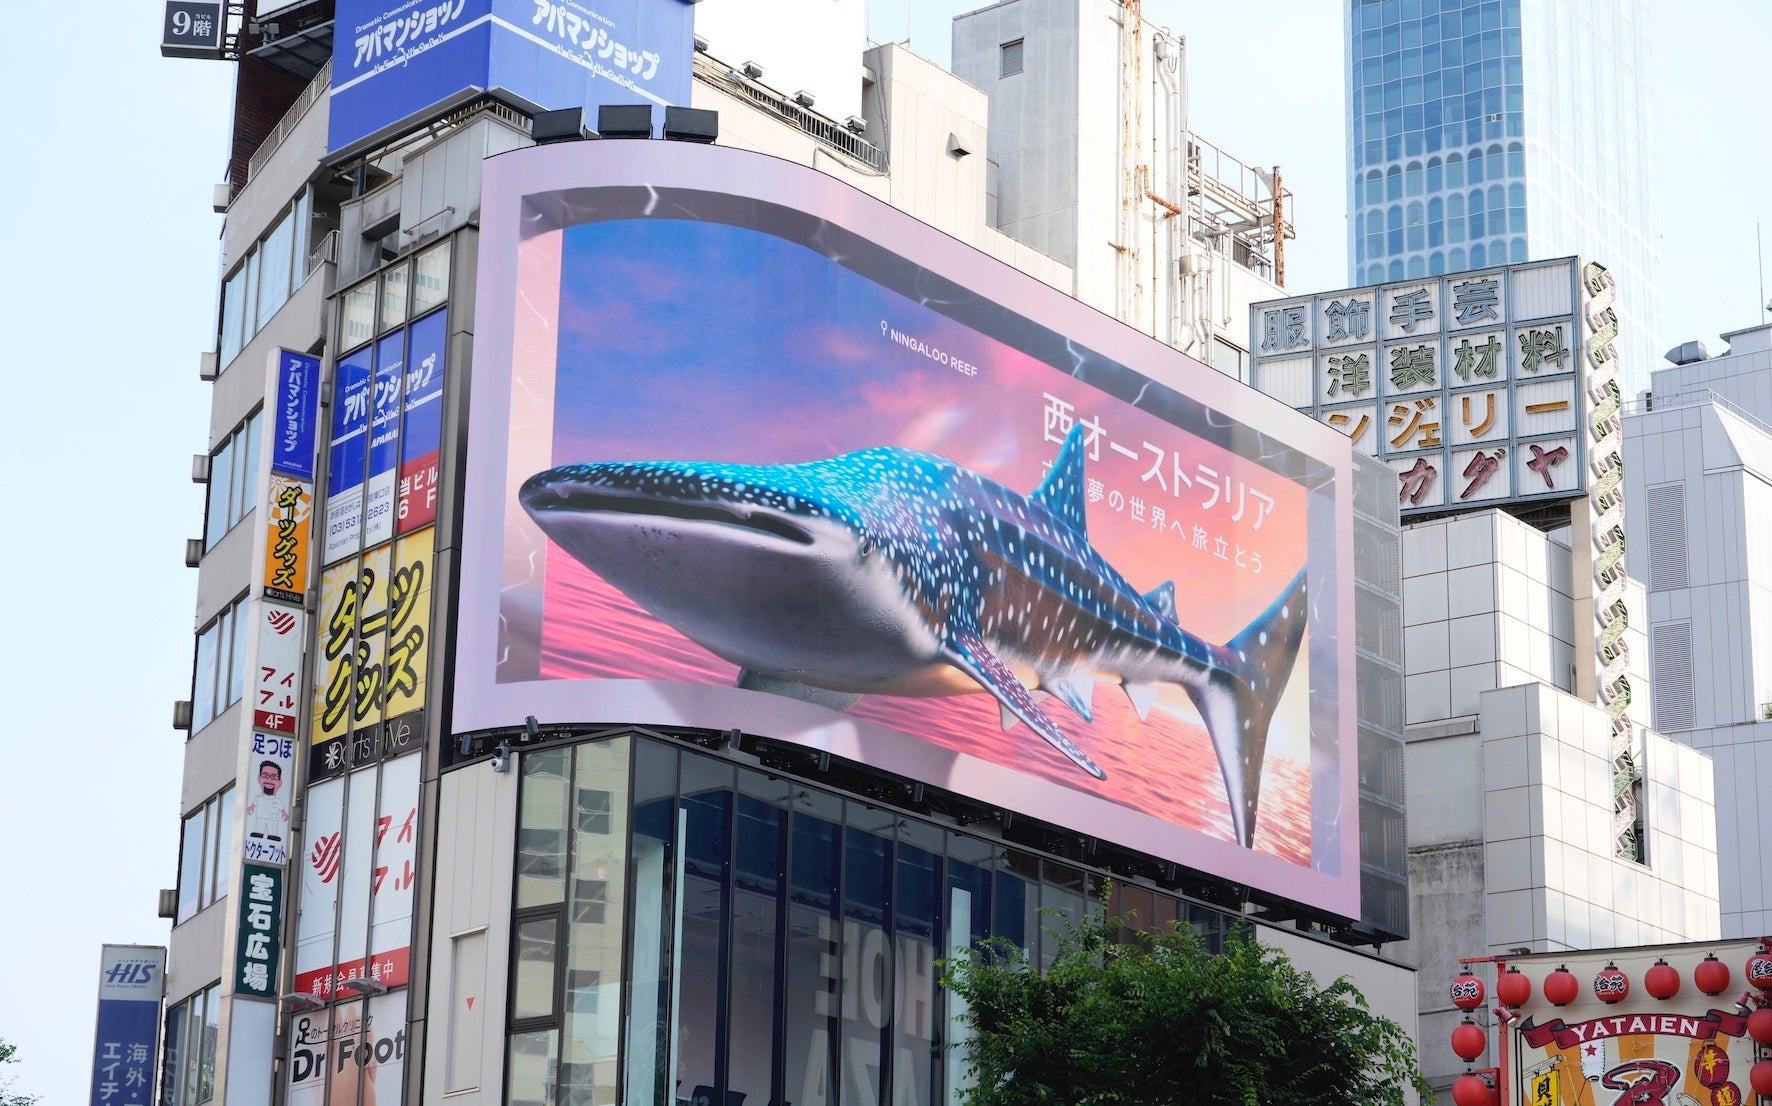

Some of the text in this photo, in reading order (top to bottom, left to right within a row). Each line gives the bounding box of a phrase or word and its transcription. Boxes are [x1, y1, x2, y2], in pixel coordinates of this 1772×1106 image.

[1261, 279, 1498, 351] 服飾手芸
[890, 328, 978, 377] NINGALOO REEF
[1326, 326, 1570, 397] 洋装材料
[284, 358, 303, 453] アパマンショップ
[399, 466, 438, 499] 当ビル
[1043, 392, 1275, 531] 西オーストラリア
[398, 487, 437, 520] 6 F
[1087, 477, 1264, 574] 夢の世界へ旅立とう
[272, 485, 303, 588] ダーツグッズ
[252, 733, 293, 759] 足つぼ
[264, 713, 285, 730] 4F
[242, 873, 275, 992] 宝石広場
[311, 959, 394, 996] 新規会員集中
[292, 1028, 406, 1083] Dr Foot
[1570, 1016, 1699, 1042] YATAIEN
[125, 1043, 149, 1106] 海外・
